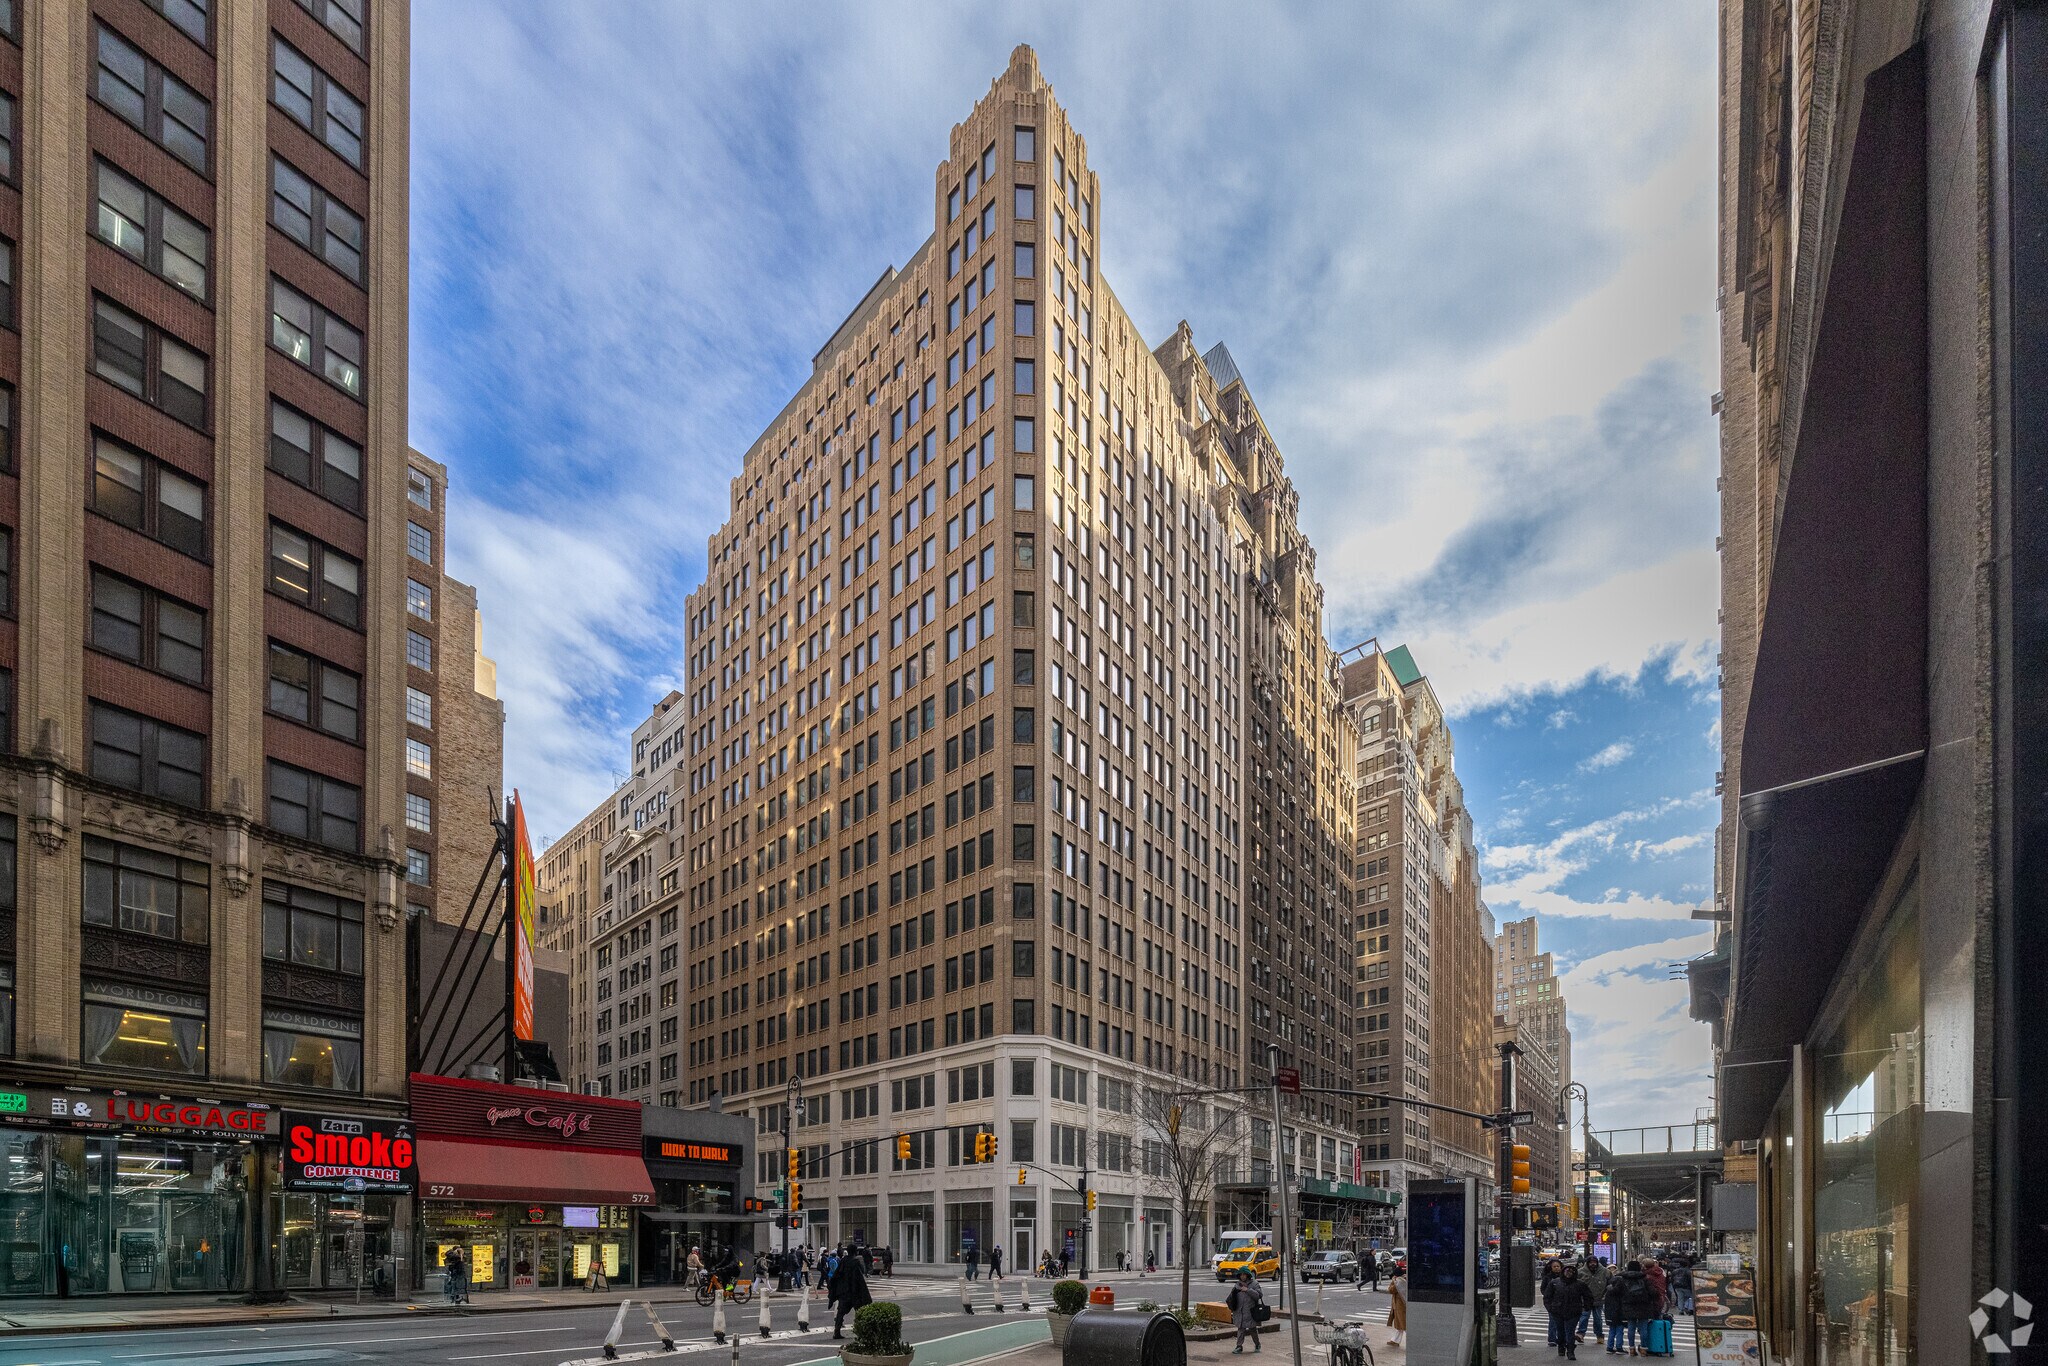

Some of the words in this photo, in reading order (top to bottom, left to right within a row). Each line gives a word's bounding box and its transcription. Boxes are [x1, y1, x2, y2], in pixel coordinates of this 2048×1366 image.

[91, 982, 202, 1008] WORLDTONE
[266, 1011, 358, 1032] WORLDTONE
[72, 1102, 91, 1117] &
[107, 1098, 267, 1132] LUGGAGE
[525, 1107, 592, 1137] Café
[134, 1125, 159, 1133] TAXI
[213, 1131, 265, 1140] SOUVENIRS
[323, 1121, 361, 1132] Zara
[290, 1125, 413, 1169] Smoke
[661, 1143, 686, 1158] WOK
[688, 1145, 700, 1159] TO
[701, 1146, 729, 1161] WALK
[304, 1164, 400, 1182] CONVENIENCE
[430, 1185, 454, 1196] 572
[631, 1194, 650, 1203] 572
[514, 1277, 532, 1286] ATM
